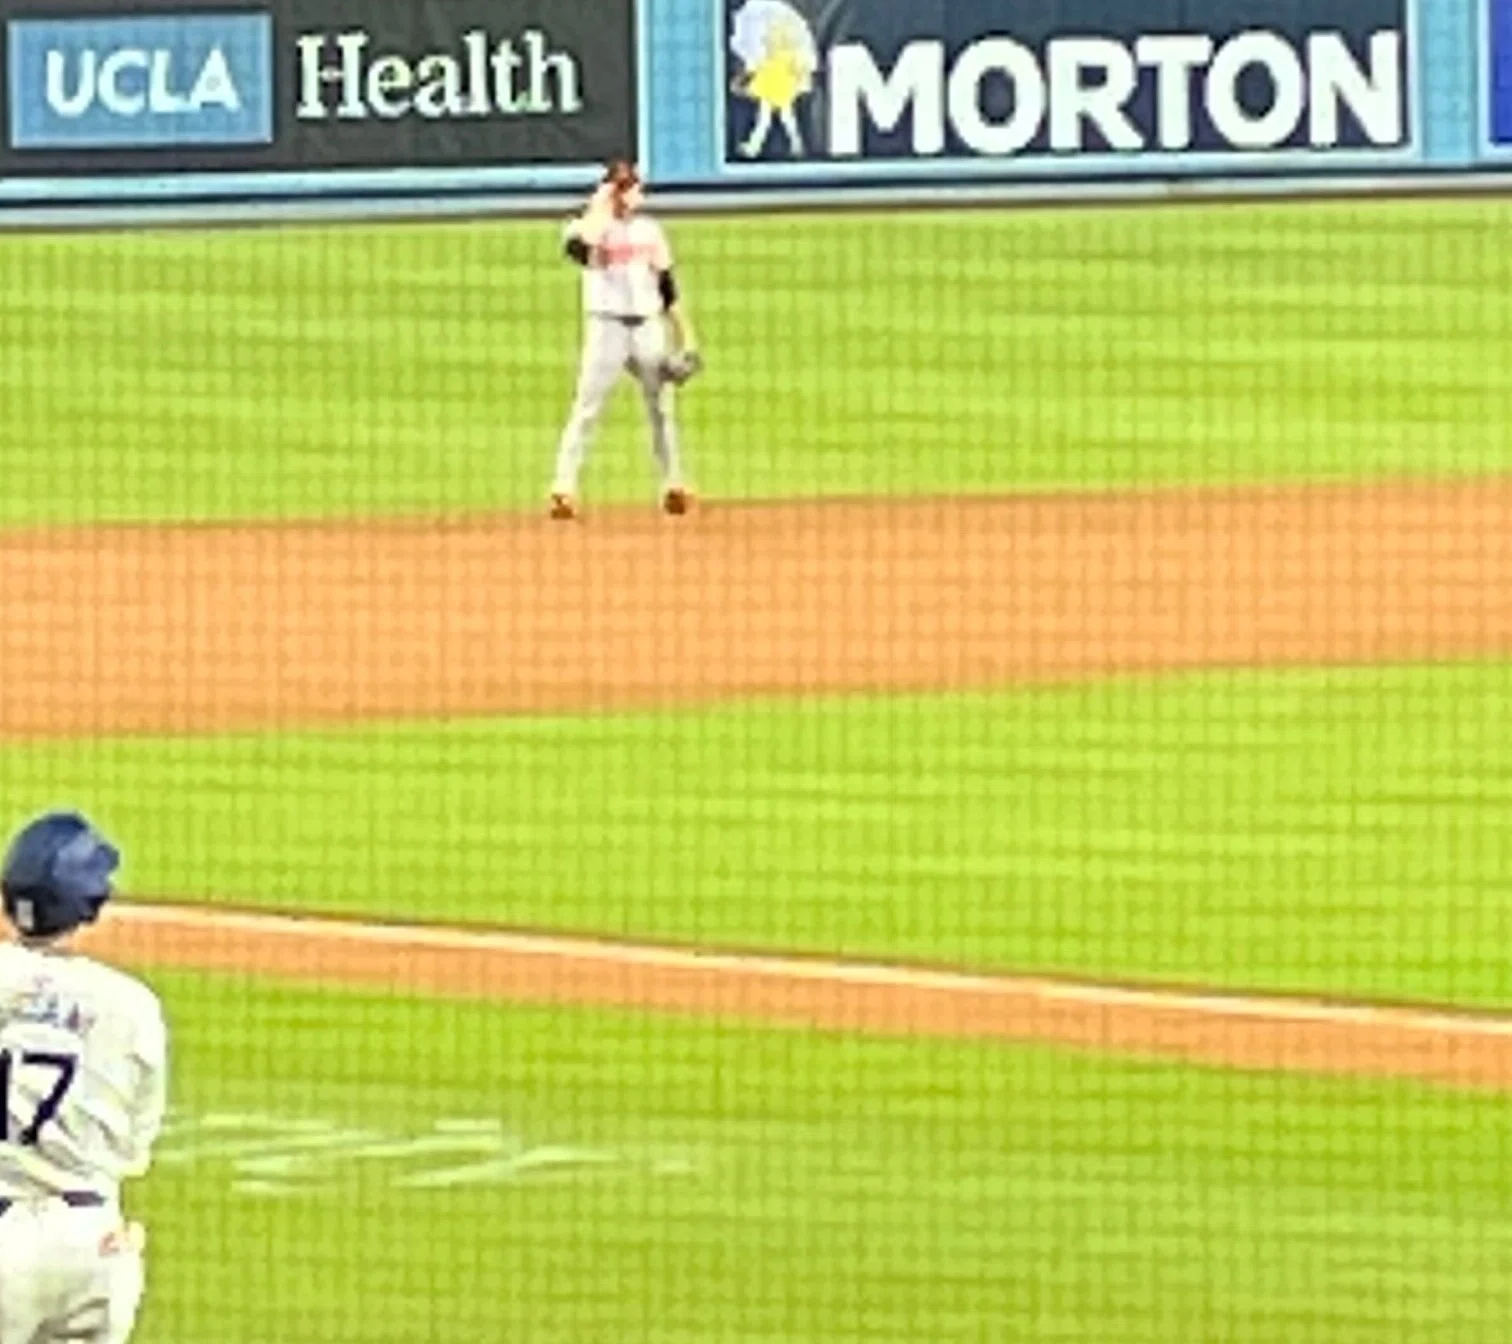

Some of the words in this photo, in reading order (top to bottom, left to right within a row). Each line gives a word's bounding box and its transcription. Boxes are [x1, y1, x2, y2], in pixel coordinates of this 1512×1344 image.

[44, 42, 241, 119] UCLA
[295, 29, 582, 120] Health
[826, 29, 1401, 156] MORTON
